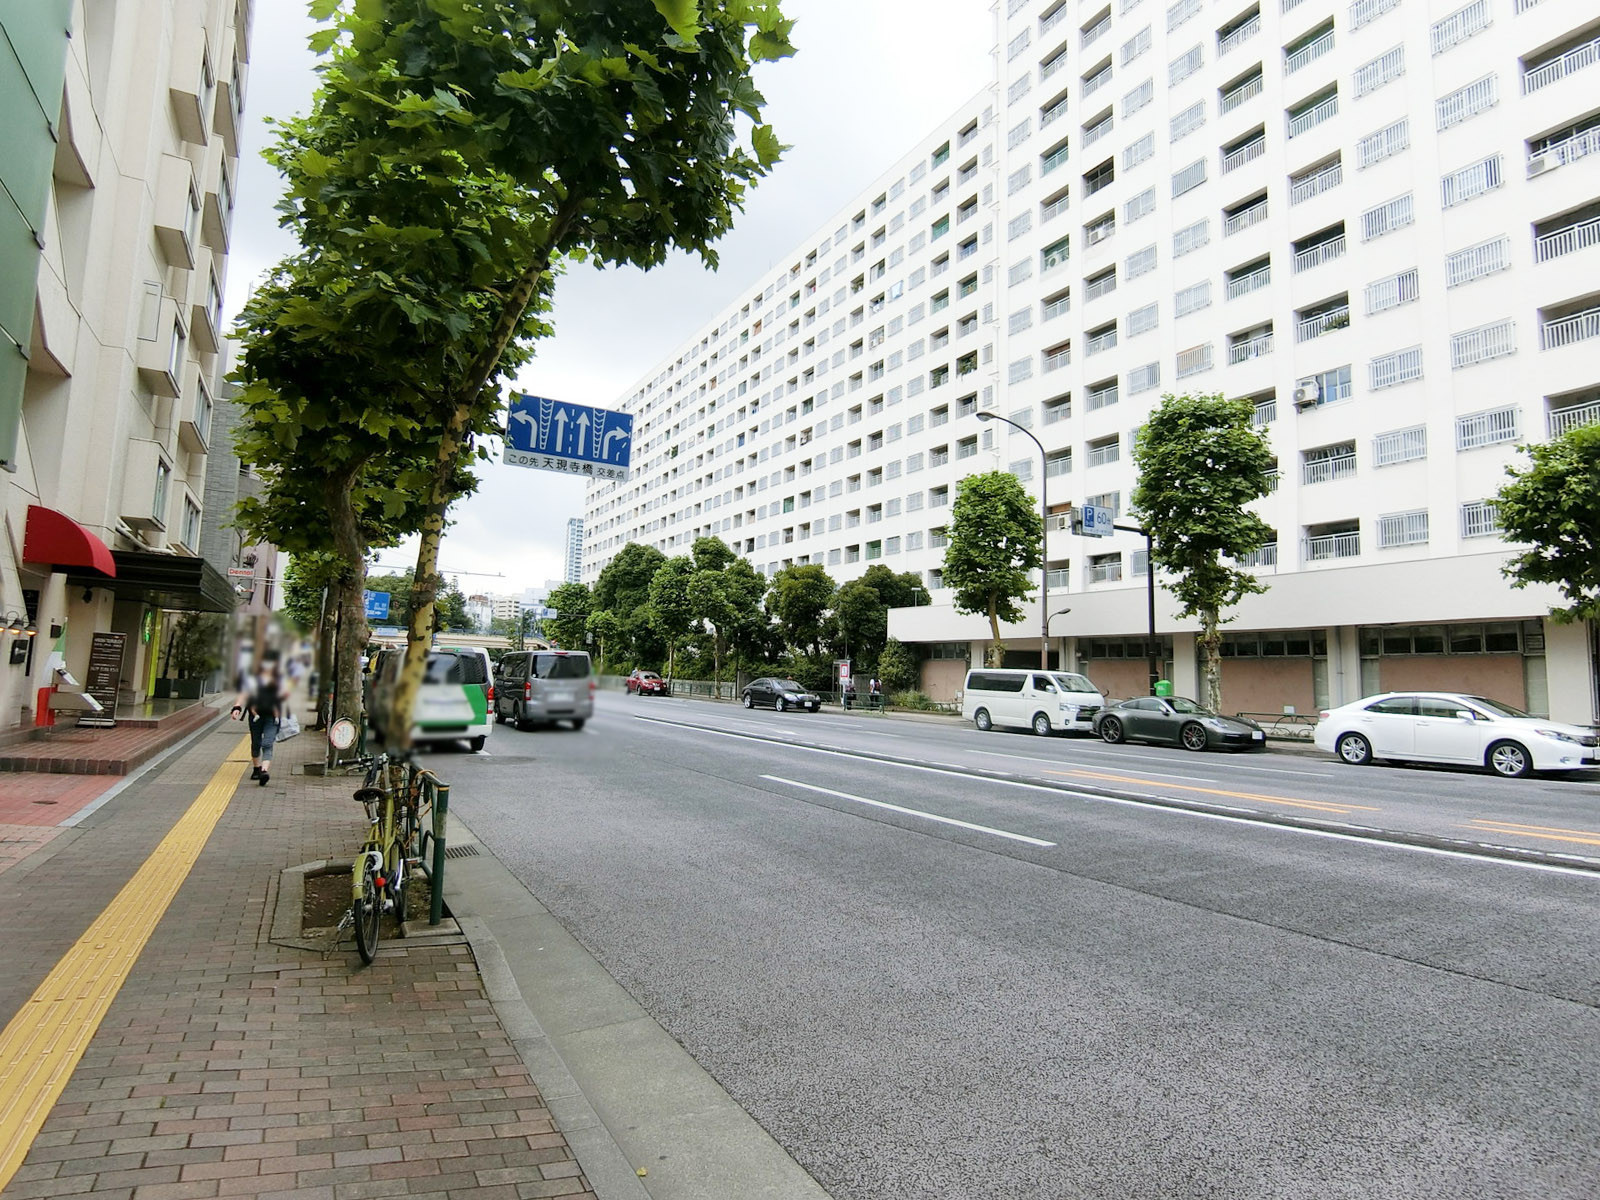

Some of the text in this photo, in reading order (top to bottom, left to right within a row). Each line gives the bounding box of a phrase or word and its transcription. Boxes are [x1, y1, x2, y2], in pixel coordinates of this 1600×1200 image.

[508, 454, 626, 480] この先 天現寺橋 交差点
